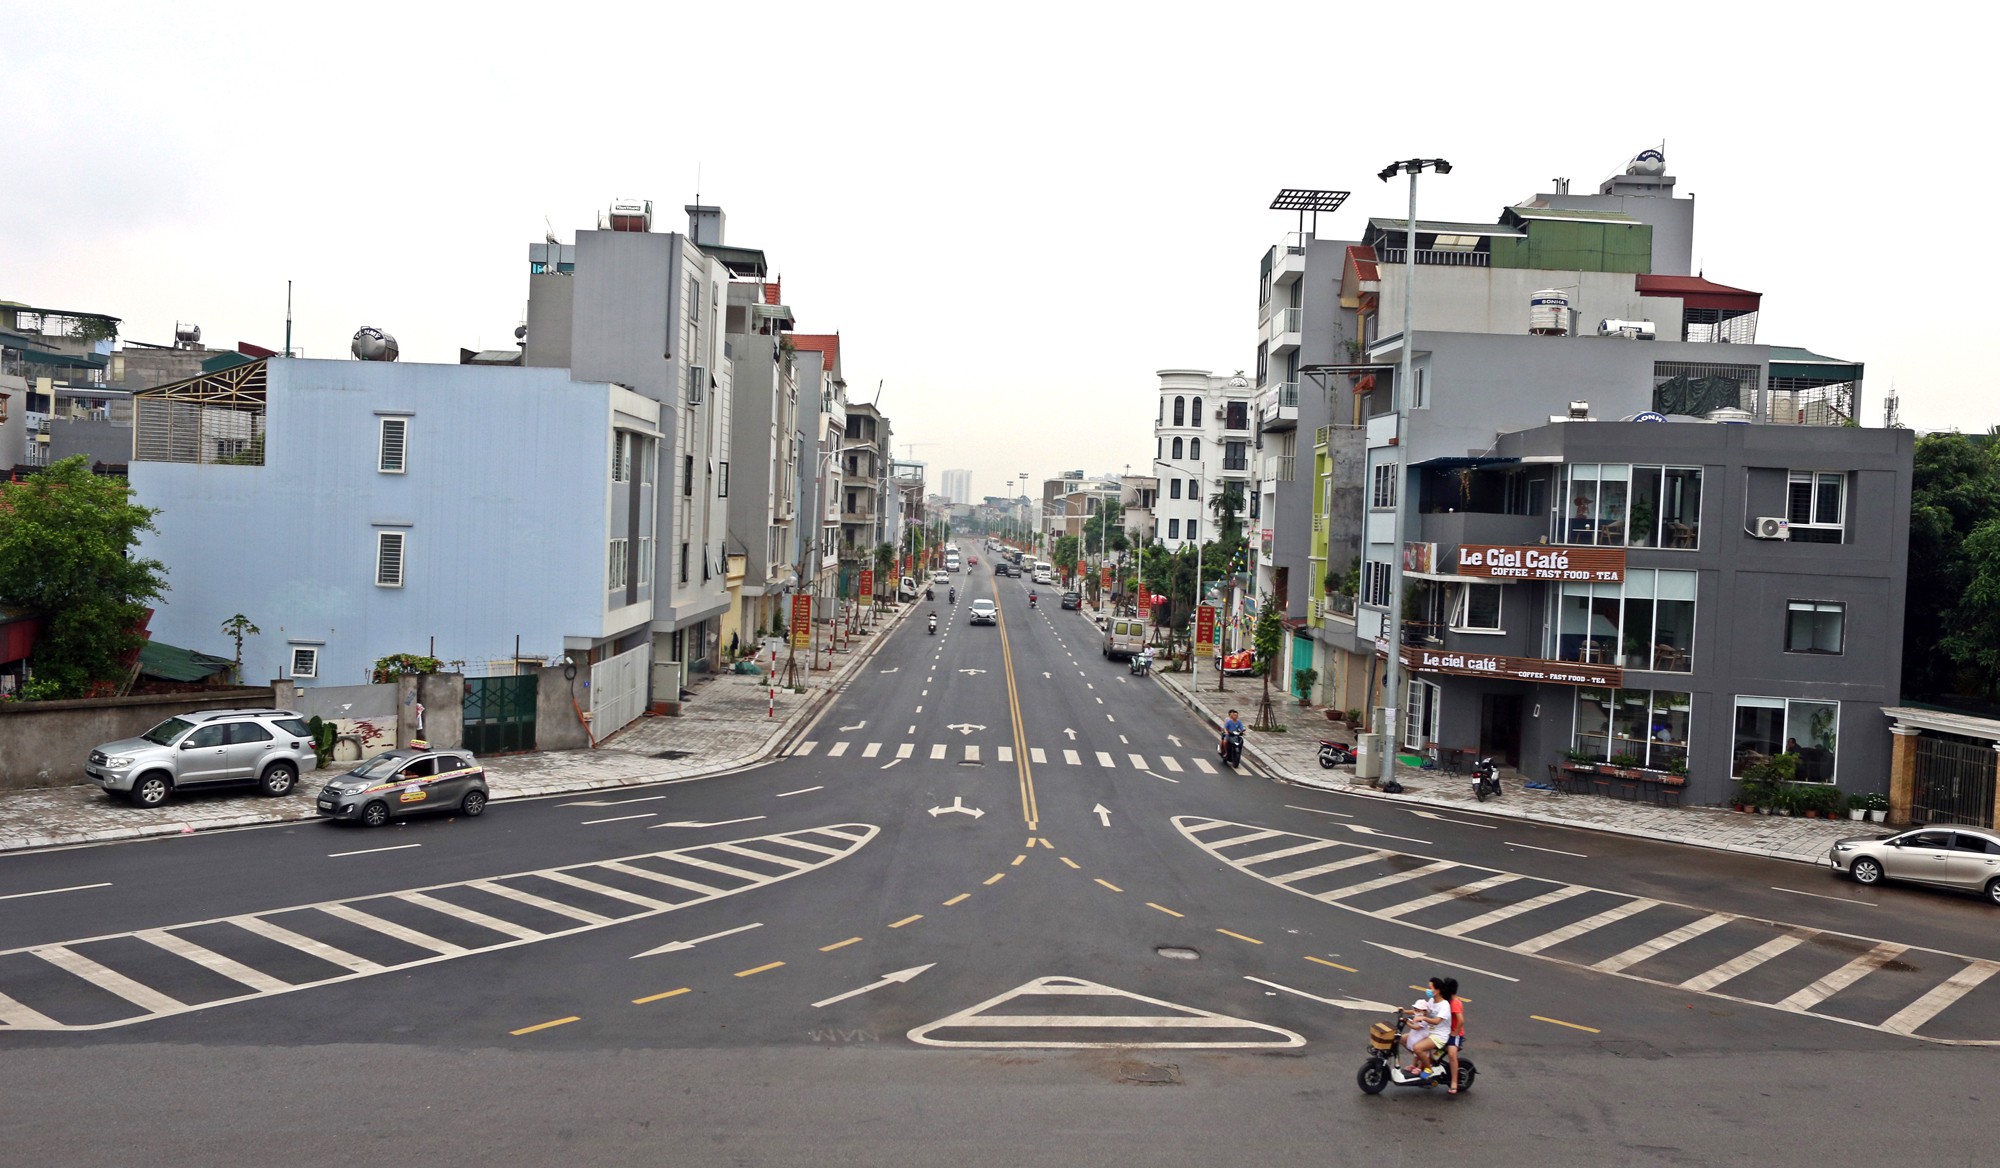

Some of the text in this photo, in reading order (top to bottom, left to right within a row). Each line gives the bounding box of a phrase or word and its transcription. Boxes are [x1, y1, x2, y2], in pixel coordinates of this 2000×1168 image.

[1636, 414, 1667, 423] ONH
[1459, 548, 1569, 570] Le Ciel Café
[1491, 567, 1529, 577] COFFEE
[1535, 569, 1562, 579] FAST
[1563, 570, 1590, 580] FOOD
[1596, 571, 1619, 581] TEA
[1423, 652, 1440, 666] Le
[1441, 654, 1465, 668] ciel
[1467, 657, 1497, 671] café
[1518, 671, 1544, 679] COFFEE
[1549, 673, 1567, 681] FAST
